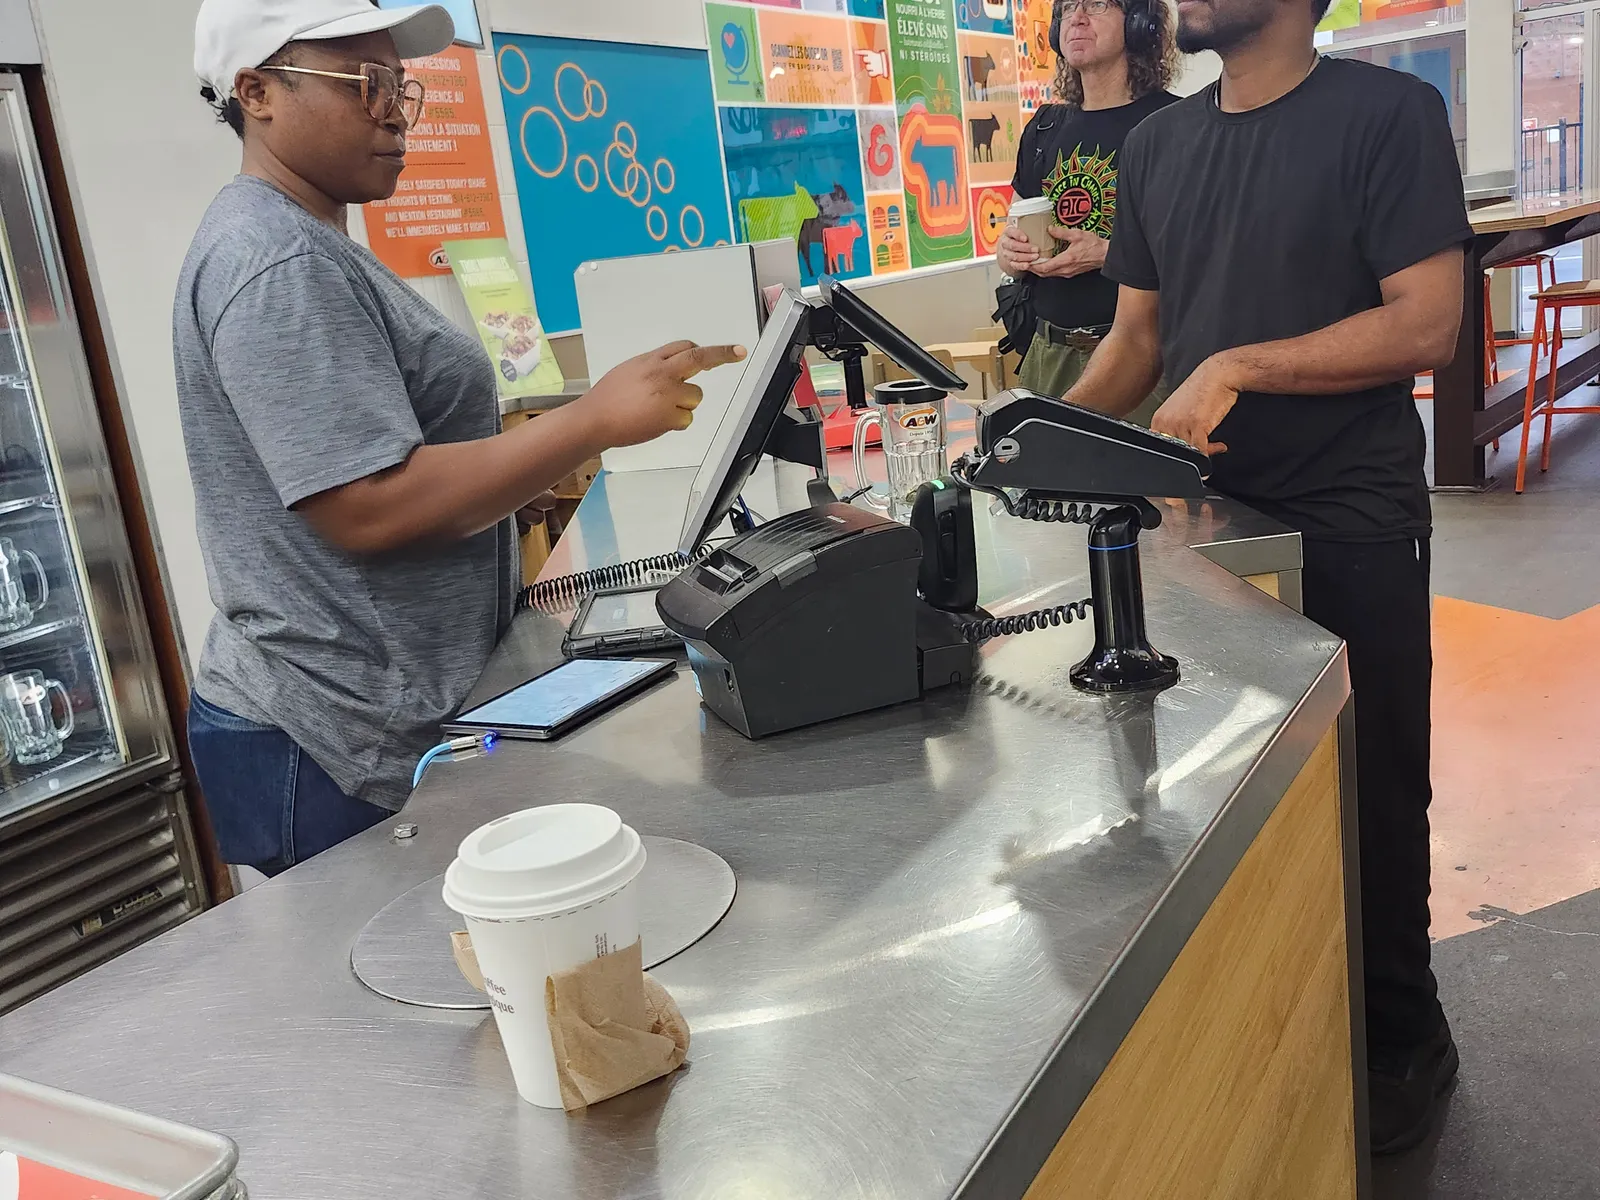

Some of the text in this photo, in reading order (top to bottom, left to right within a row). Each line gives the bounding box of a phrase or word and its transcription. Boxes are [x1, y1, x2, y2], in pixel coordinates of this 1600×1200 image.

[897, 16, 948, 40] ÉLEVÉ SANS
[900, 49, 908, 61] NI
[435, 123, 445, 136] LA
[446, 123, 481, 136] SITUATION
[905, 413, 938, 428] A&W
